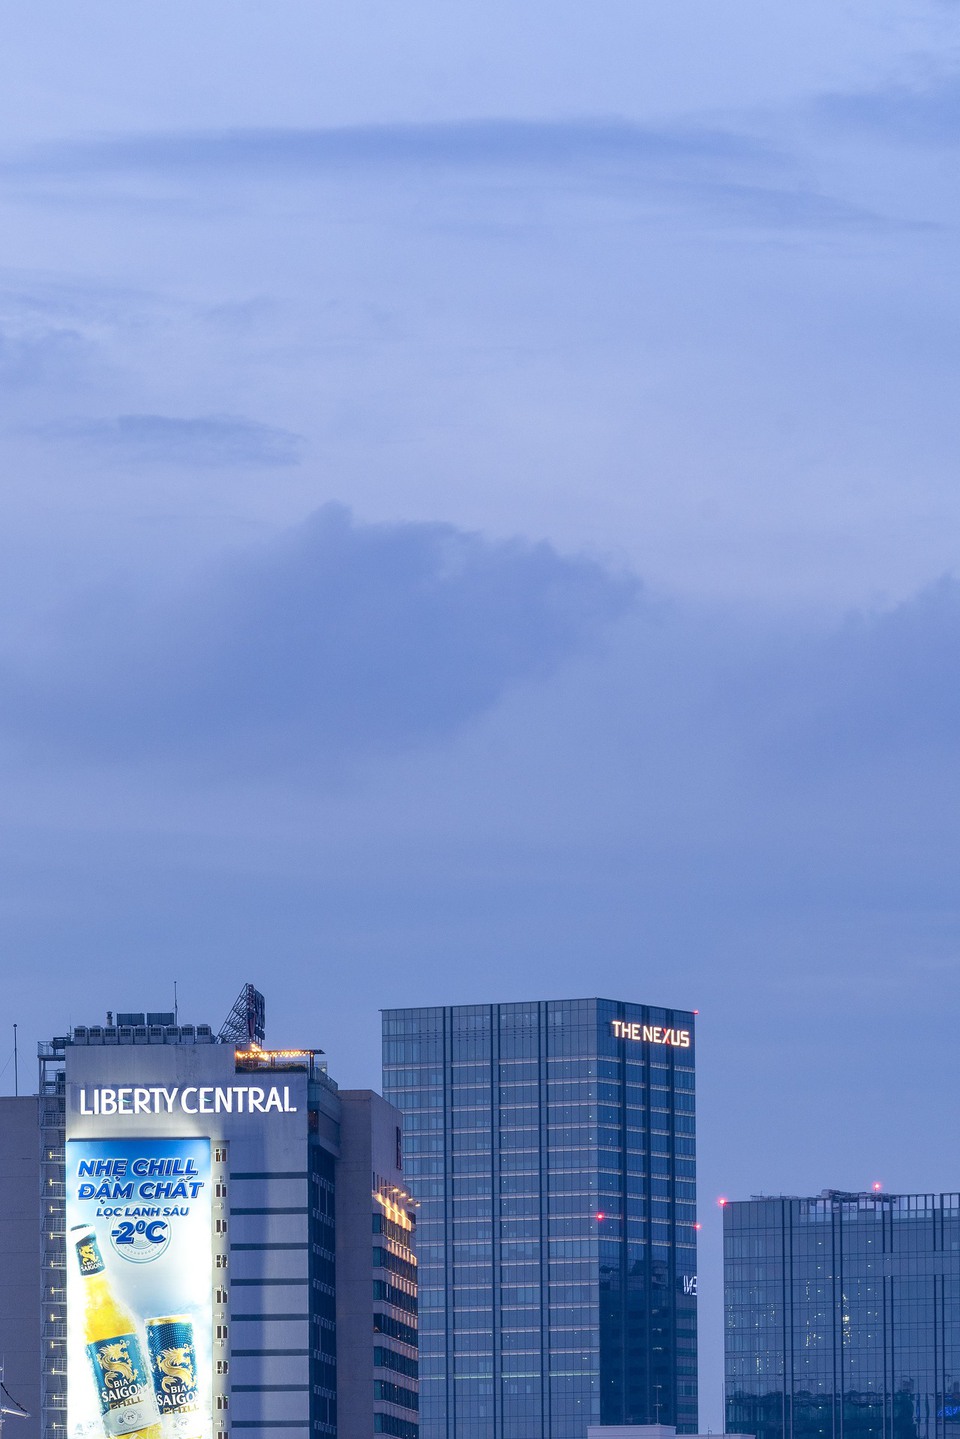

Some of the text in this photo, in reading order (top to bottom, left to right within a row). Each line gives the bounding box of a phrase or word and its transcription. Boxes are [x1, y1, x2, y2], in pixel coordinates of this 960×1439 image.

[612, 1020, 690, 1047] THE NEXUS
[79, 1086, 297, 1115] LIBERTY CENTRAL
[78, 1159, 198, 1181] NHẸ CHILL
[78, 1176, 205, 1204] ĐẬM CHẤT
[96, 1205, 189, 1219] LỌC LẠNH SÂU
[113, 1379, 129, 1388] BIA
[170, 1385, 187, 1393] BIA
